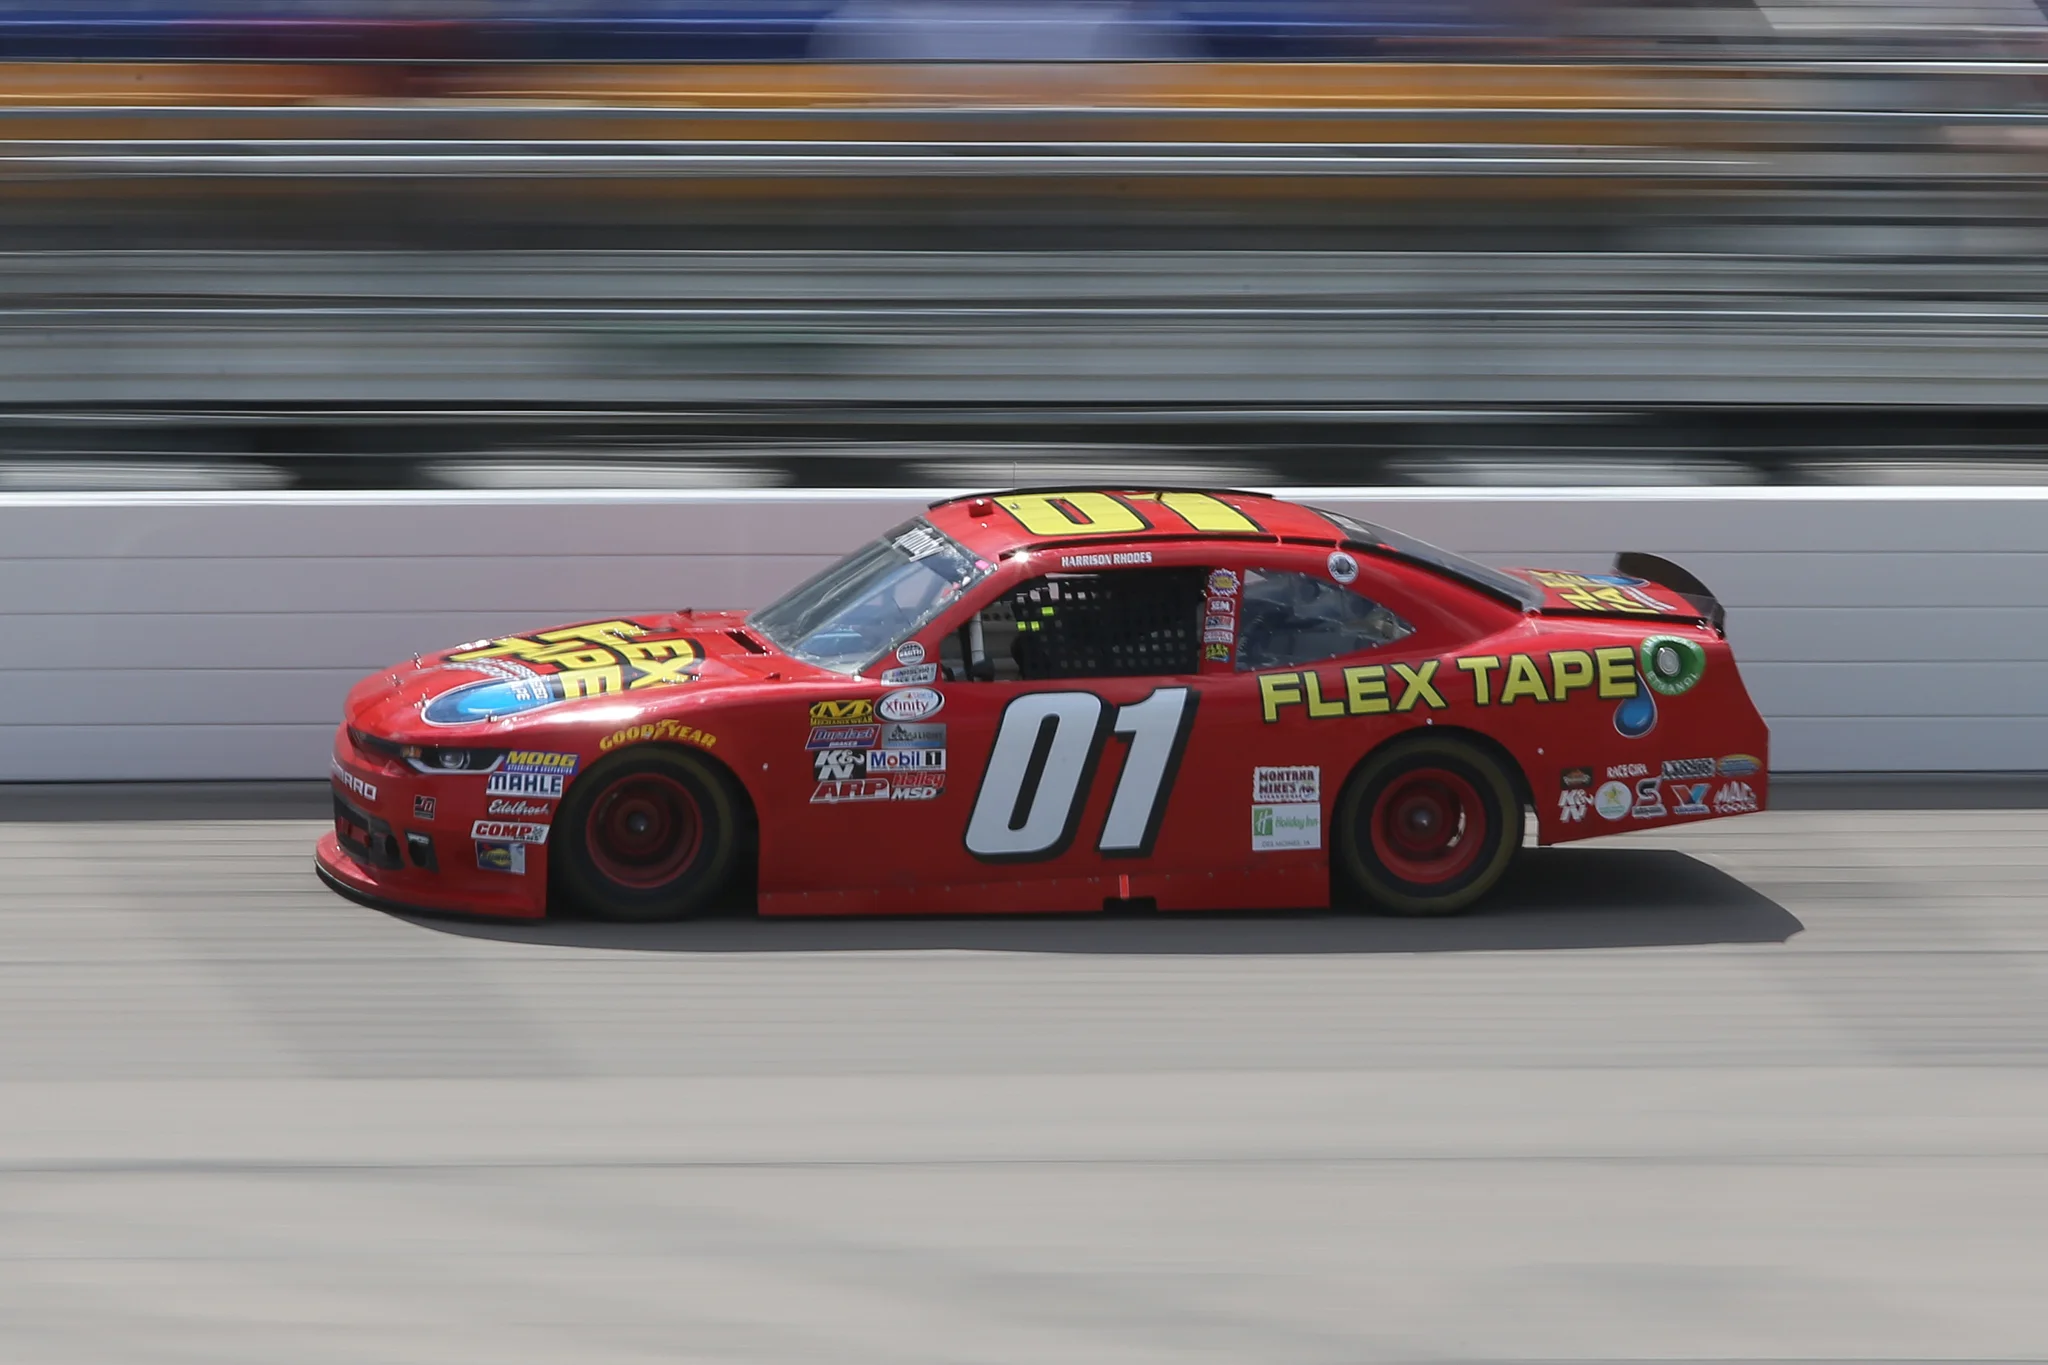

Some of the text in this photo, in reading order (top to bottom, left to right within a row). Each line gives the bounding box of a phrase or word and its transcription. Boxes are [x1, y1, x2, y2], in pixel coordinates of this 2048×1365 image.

[992, 491, 1262, 536] 01
[1061, 551, 1152, 567] HARRISON RHODES
[1257, 646, 1638, 723] FLEX TAPE
[1646, 670, 1700, 694] ETHANOL
[885, 699, 929, 714] xfinity
[850, 716, 873, 724] WEAR
[599, 718, 717, 751] GOODYEAR
[506, 751, 578, 767] MOOG
[871, 751, 920, 766] Mobil
[488, 773, 562, 793] MAHLE
[891, 772, 945, 789] Holley
[963, 686, 1201, 864] 01
[1259, 770, 1314, 781] MONTANA
[815, 781, 889, 800] ARP
[890, 787, 937, 799] MSD
[488, 799, 549, 815] Edelbrock
[475, 823, 534, 837] COMP
[1275, 815, 1319, 830] Holiday Inn
